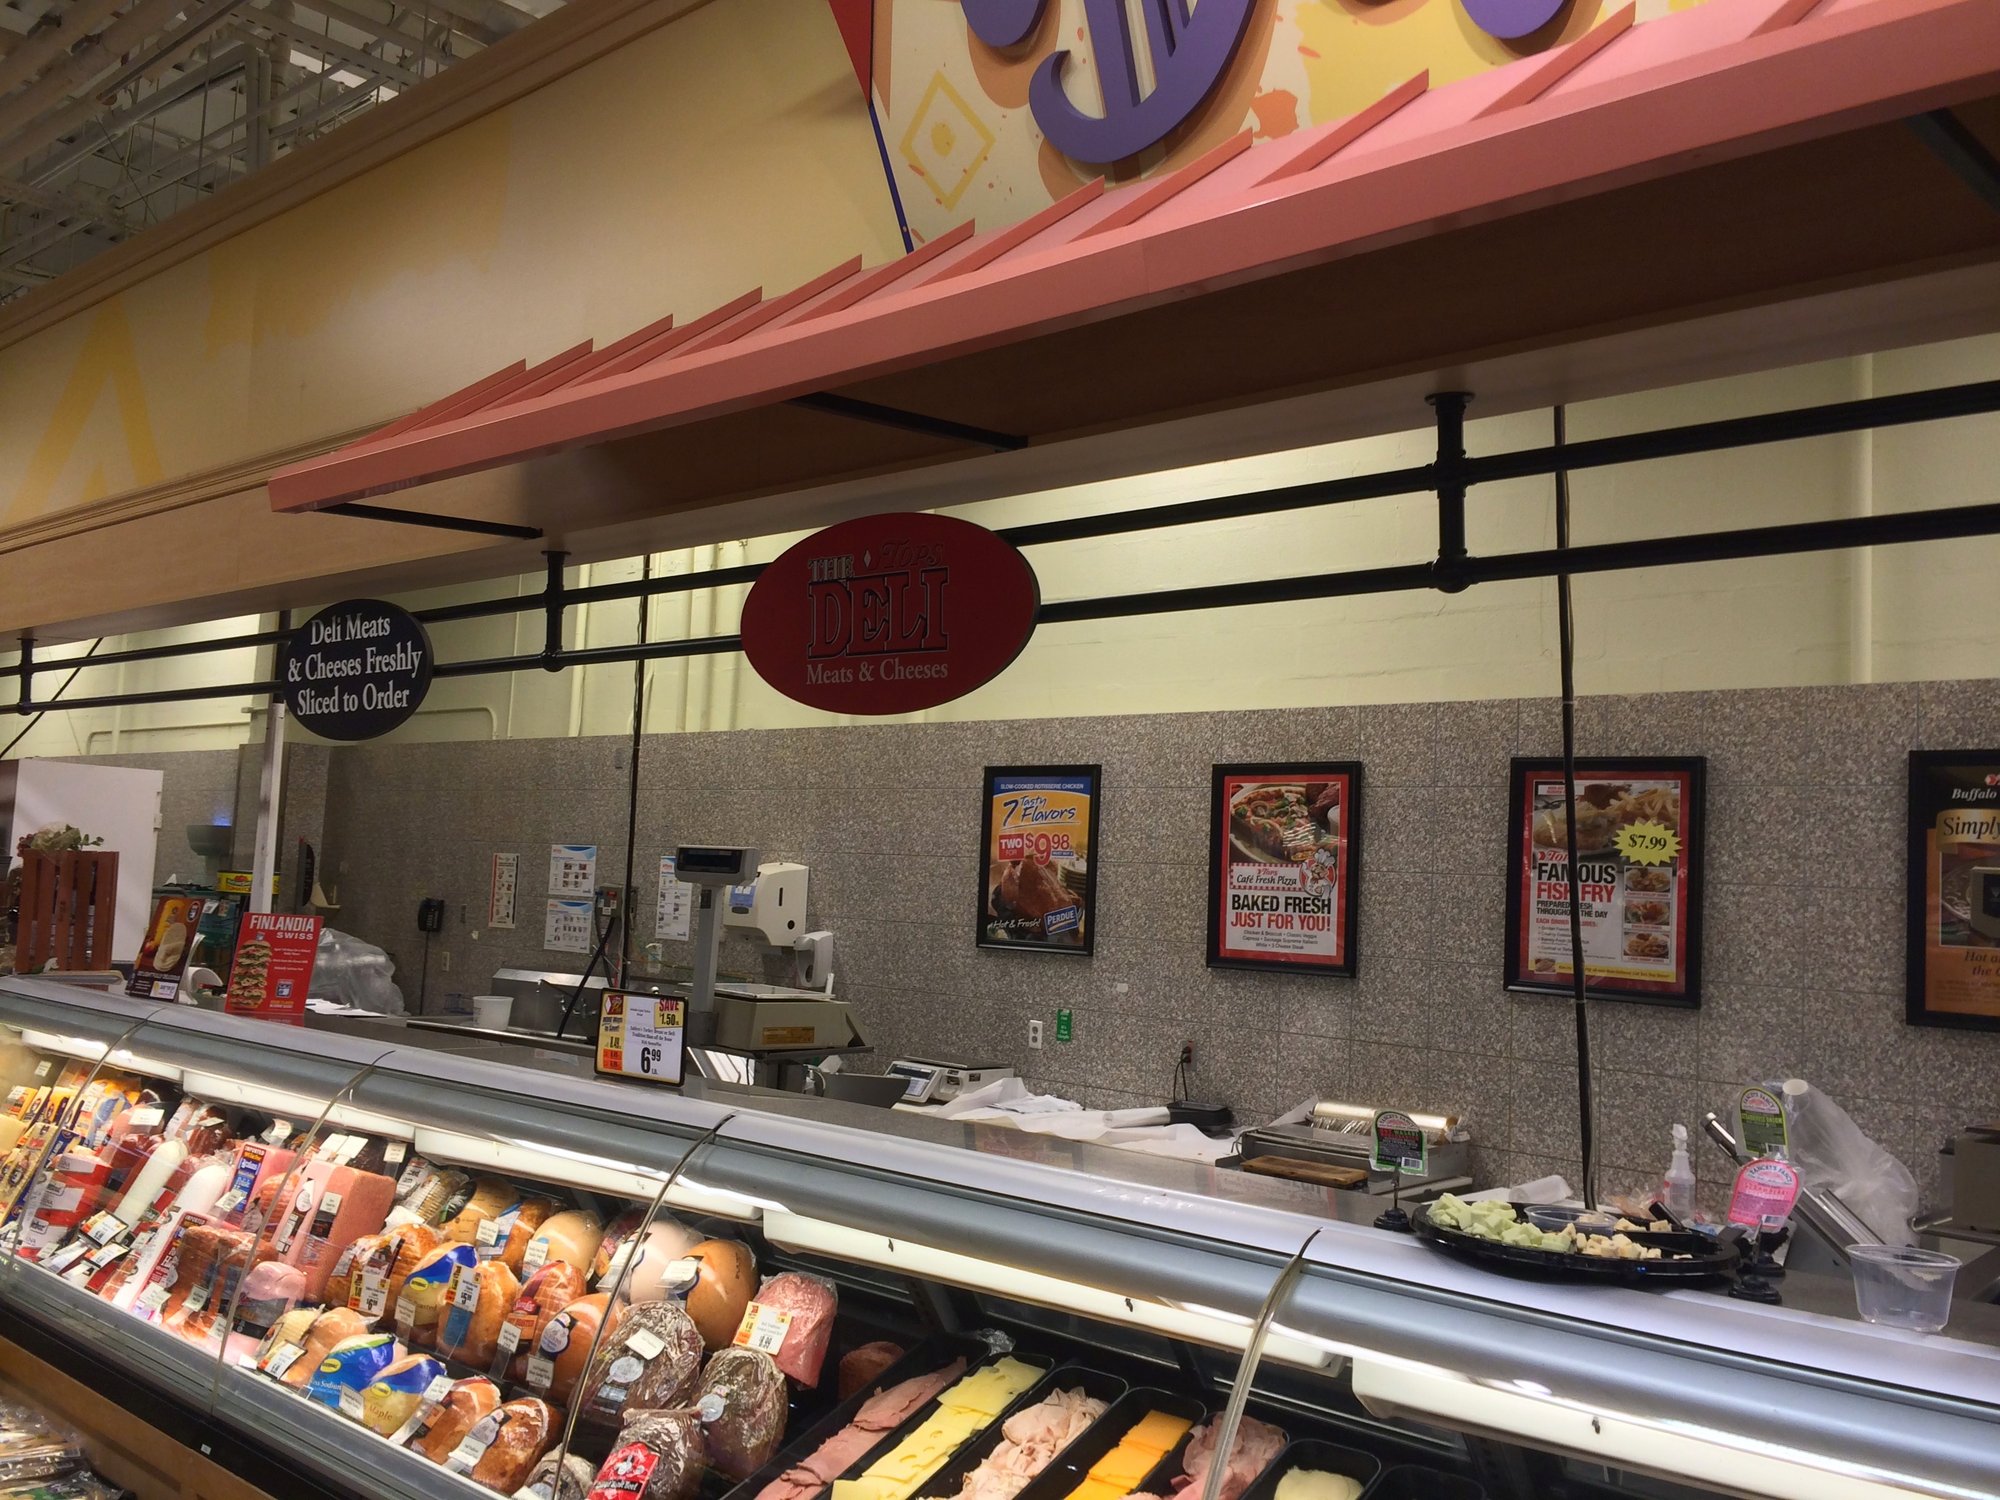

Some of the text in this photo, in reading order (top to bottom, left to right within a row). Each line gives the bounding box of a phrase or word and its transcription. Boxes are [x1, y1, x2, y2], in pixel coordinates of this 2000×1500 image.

[808, 556, 854, 580] THE
[808, 567, 949, 659] DELI
[310, 612, 391, 646] Deli Meats
[288, 640, 423, 682] & Cheeses Freshly
[806, 658, 948, 685] Meats & Cheeses
[297, 680, 410, 716] Sliced to Order
[1952, 787, 1997, 802] Buffalo
[1003, 795, 1047, 827] 7 Tasty
[1021, 806, 1076, 823] Flavors
[1000, 838, 1023, 849] TWO
[1628, 834, 1667, 851] $7.99
[1548, 851, 1568, 862] To
[1236, 874, 1298, 886] Café Fresh Pizza
[1580, 884, 1616, 903] FRY
[1232, 894, 1331, 915] BAKED FRESH
[1536, 900, 1571, 908] PREPARED
[1047, 908, 1075, 925] PERDUE
[1231, 912, 1330, 932] JUST FOR YOU!
[1536, 908, 1571, 916] THROUGHO
[1594, 911, 1608, 919] DAY
[249, 914, 314, 932] FINLANDIA
[993, 919, 1009, 929] Hot
[1009, 919, 1016, 928] &
[276, 932, 314, 940] SWISS
[1964, 951, 1988, 962] Hot
[1972, 965, 1992, 976] the
[659, 998, 680, 1012] SAVE
[369, 1405, 393, 1422] Maple
